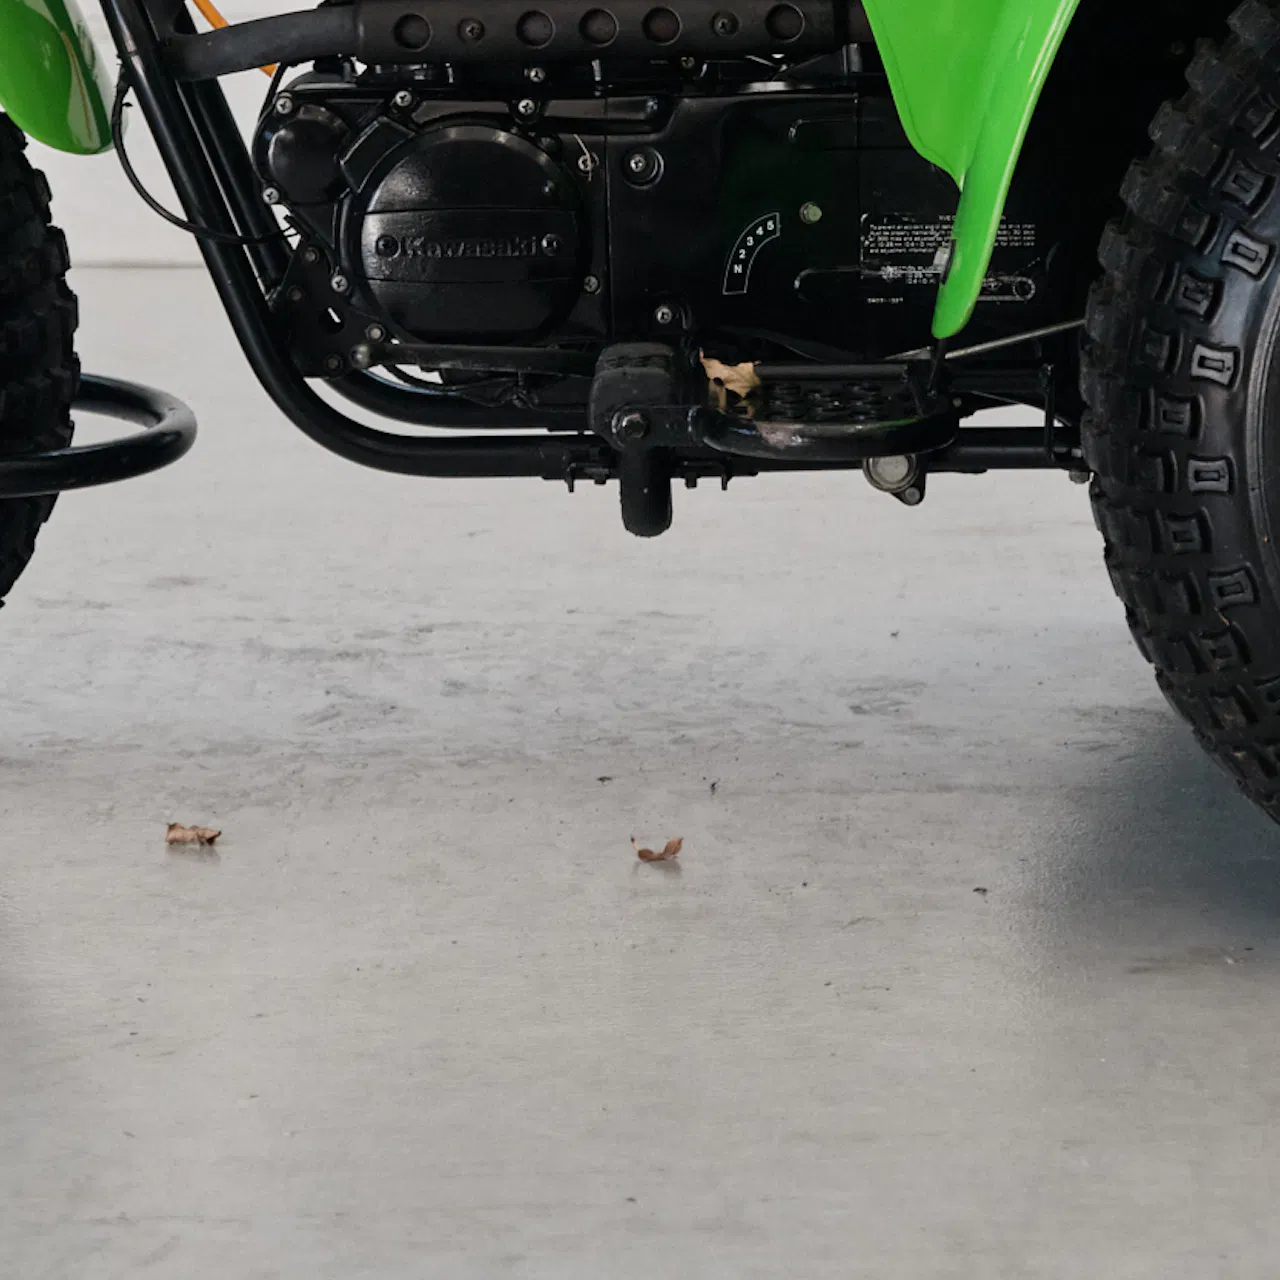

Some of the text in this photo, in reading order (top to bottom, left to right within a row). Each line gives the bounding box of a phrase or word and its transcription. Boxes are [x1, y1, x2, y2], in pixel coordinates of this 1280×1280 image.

[403, 235, 539, 259] Kawasaki
[733, 263, 743, 274] N
[738, 248, 747, 259] 2
[746, 235, 755, 247] 3
[755, 225, 765, 236] 4
